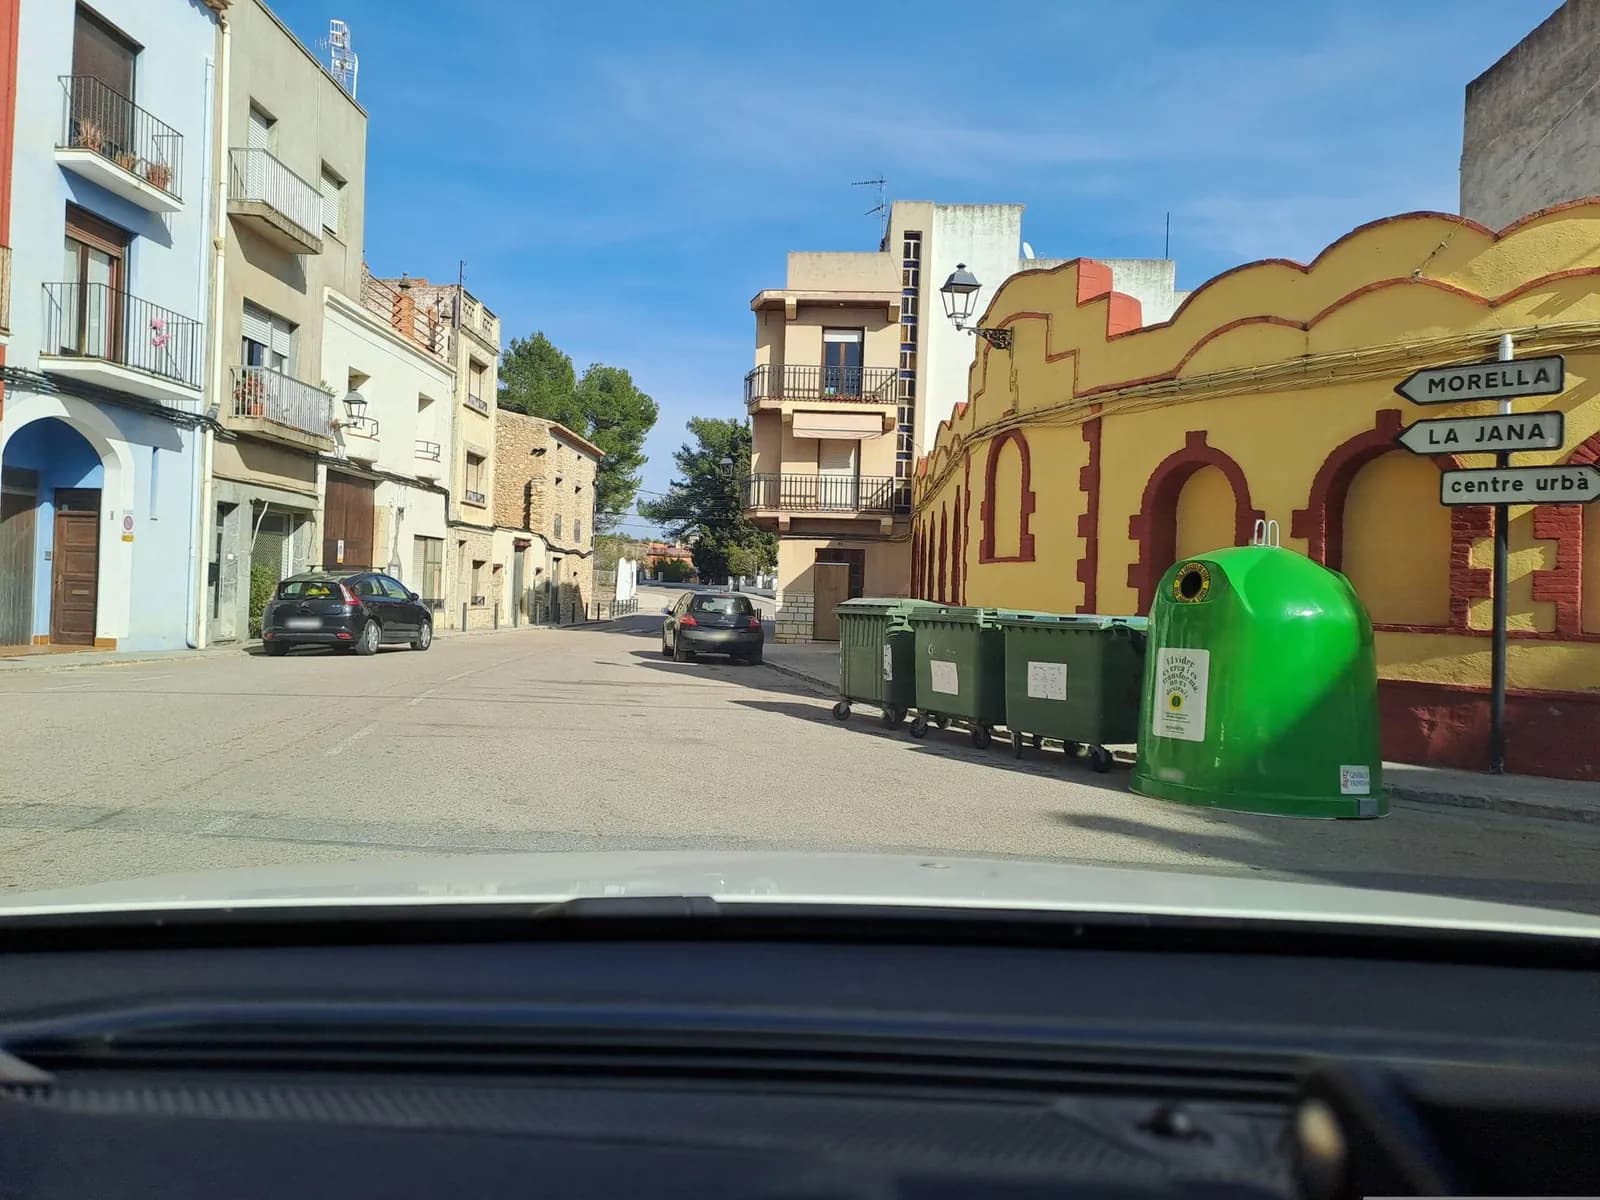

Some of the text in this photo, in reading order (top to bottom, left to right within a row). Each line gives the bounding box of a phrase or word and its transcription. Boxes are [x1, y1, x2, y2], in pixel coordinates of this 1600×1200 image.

[1428, 368, 1550, 394] MORELLA
[1429, 423, 1545, 445] LA JANA
[1451, 472, 1589, 493] centre urbà
